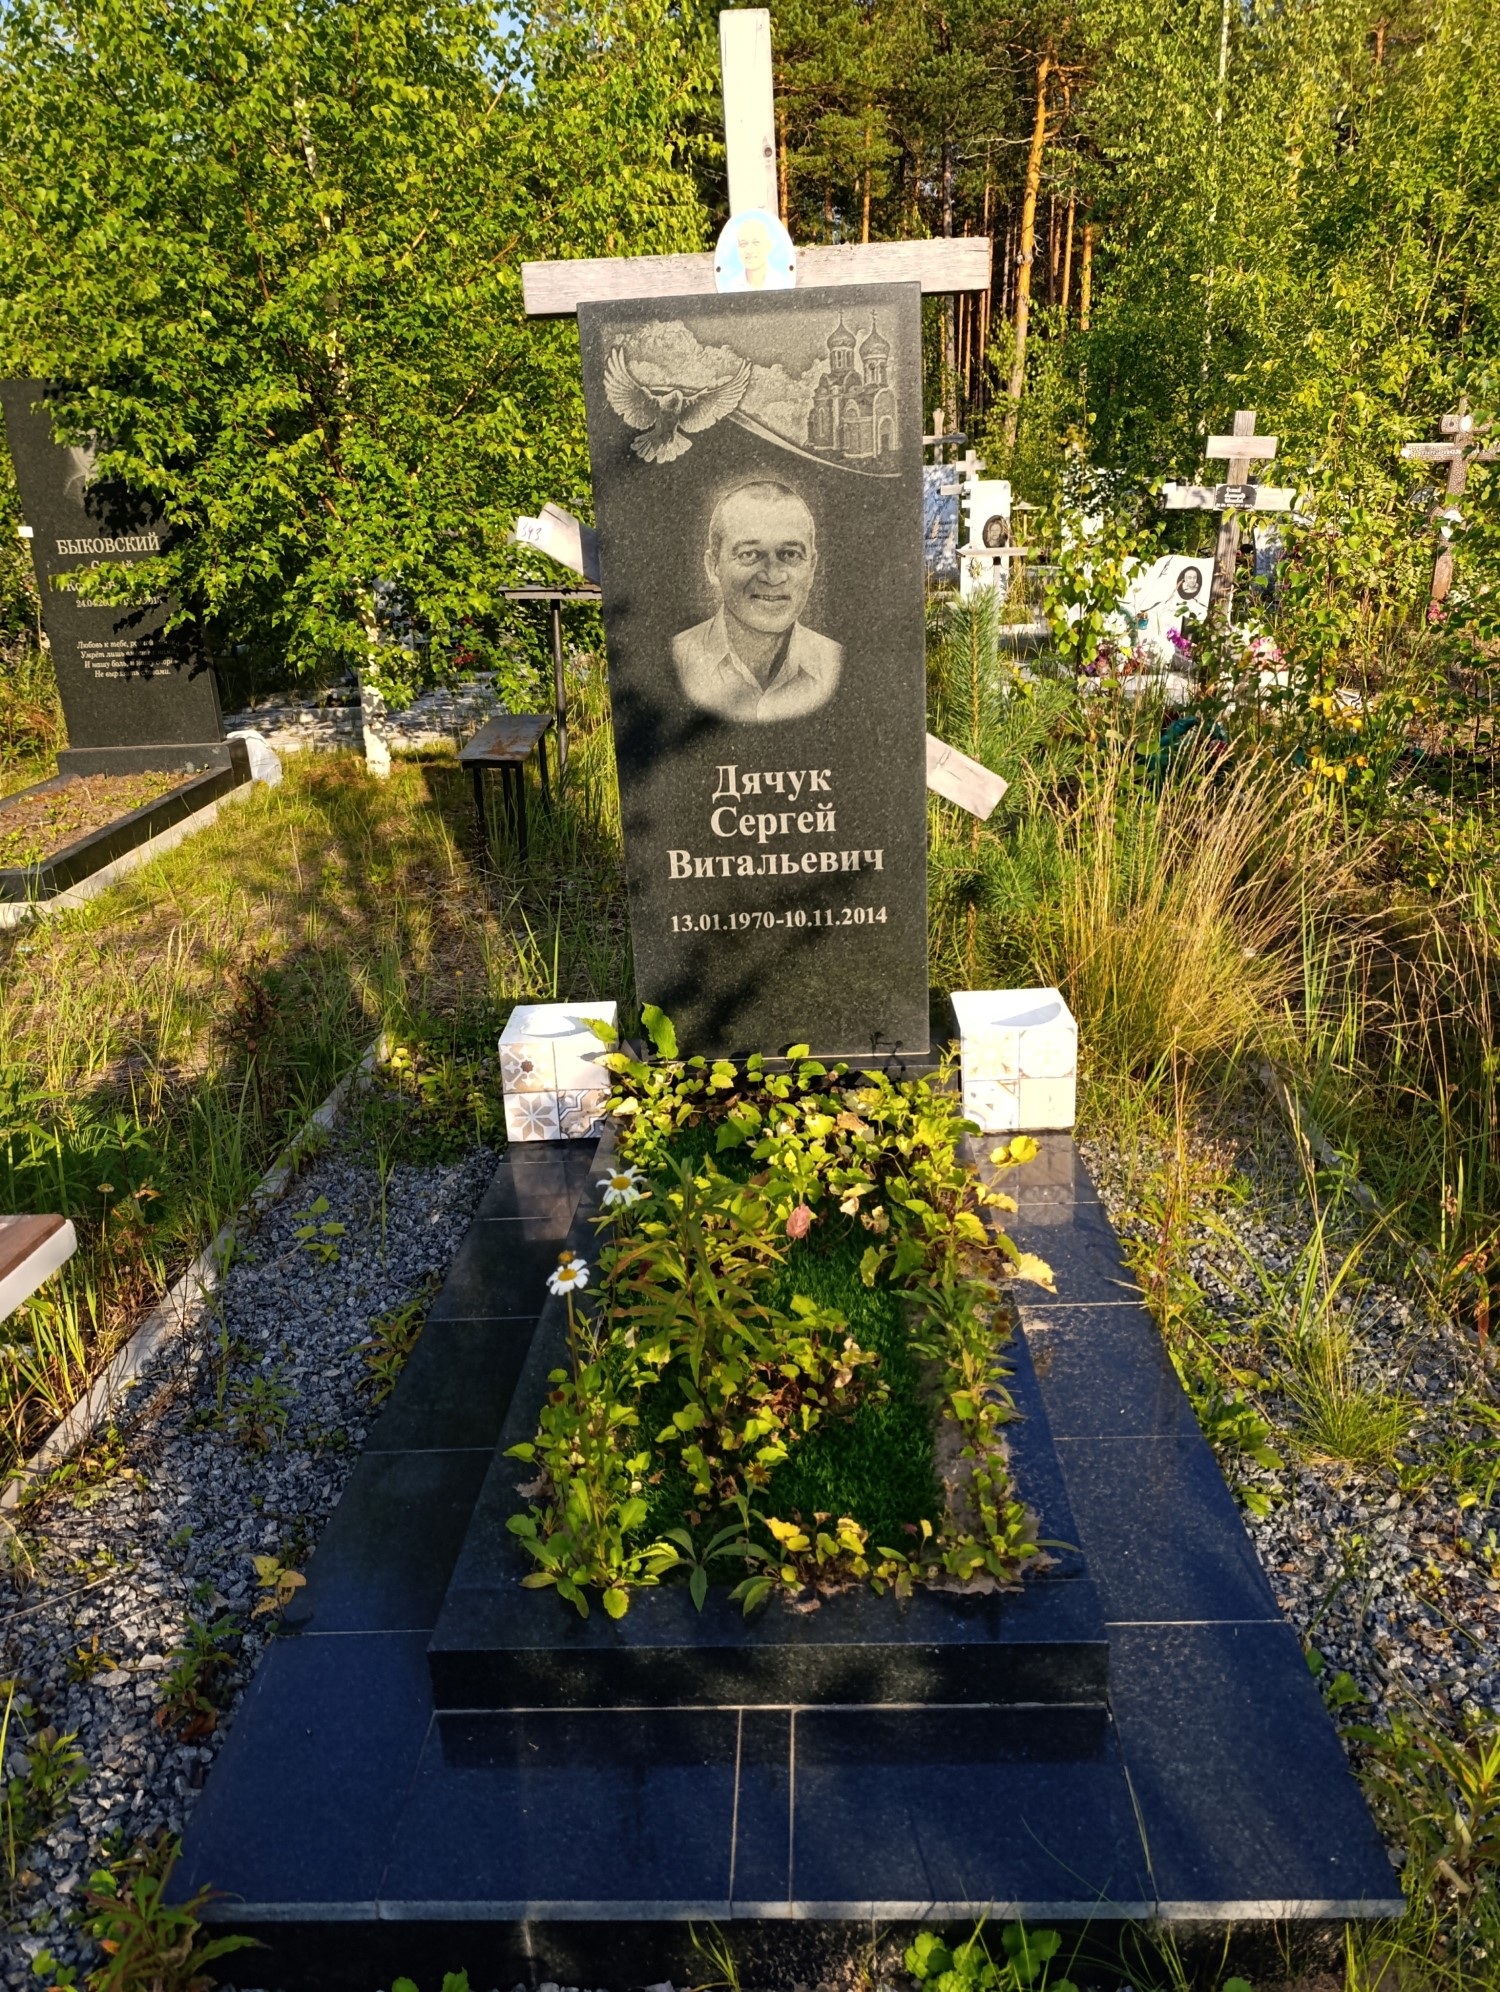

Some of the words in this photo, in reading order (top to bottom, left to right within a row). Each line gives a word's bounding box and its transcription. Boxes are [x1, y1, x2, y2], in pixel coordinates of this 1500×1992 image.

[56, 532, 161, 555] БЫКОВСКИЙ
[94, 670, 104, 678] Не
[712, 764, 832, 803] Дячук
[710, 803, 837, 843] Сергей
[666, 849, 884, 879] Витальевич
[671, 906, 888, 932] 13.01.1970-10.11.2014
